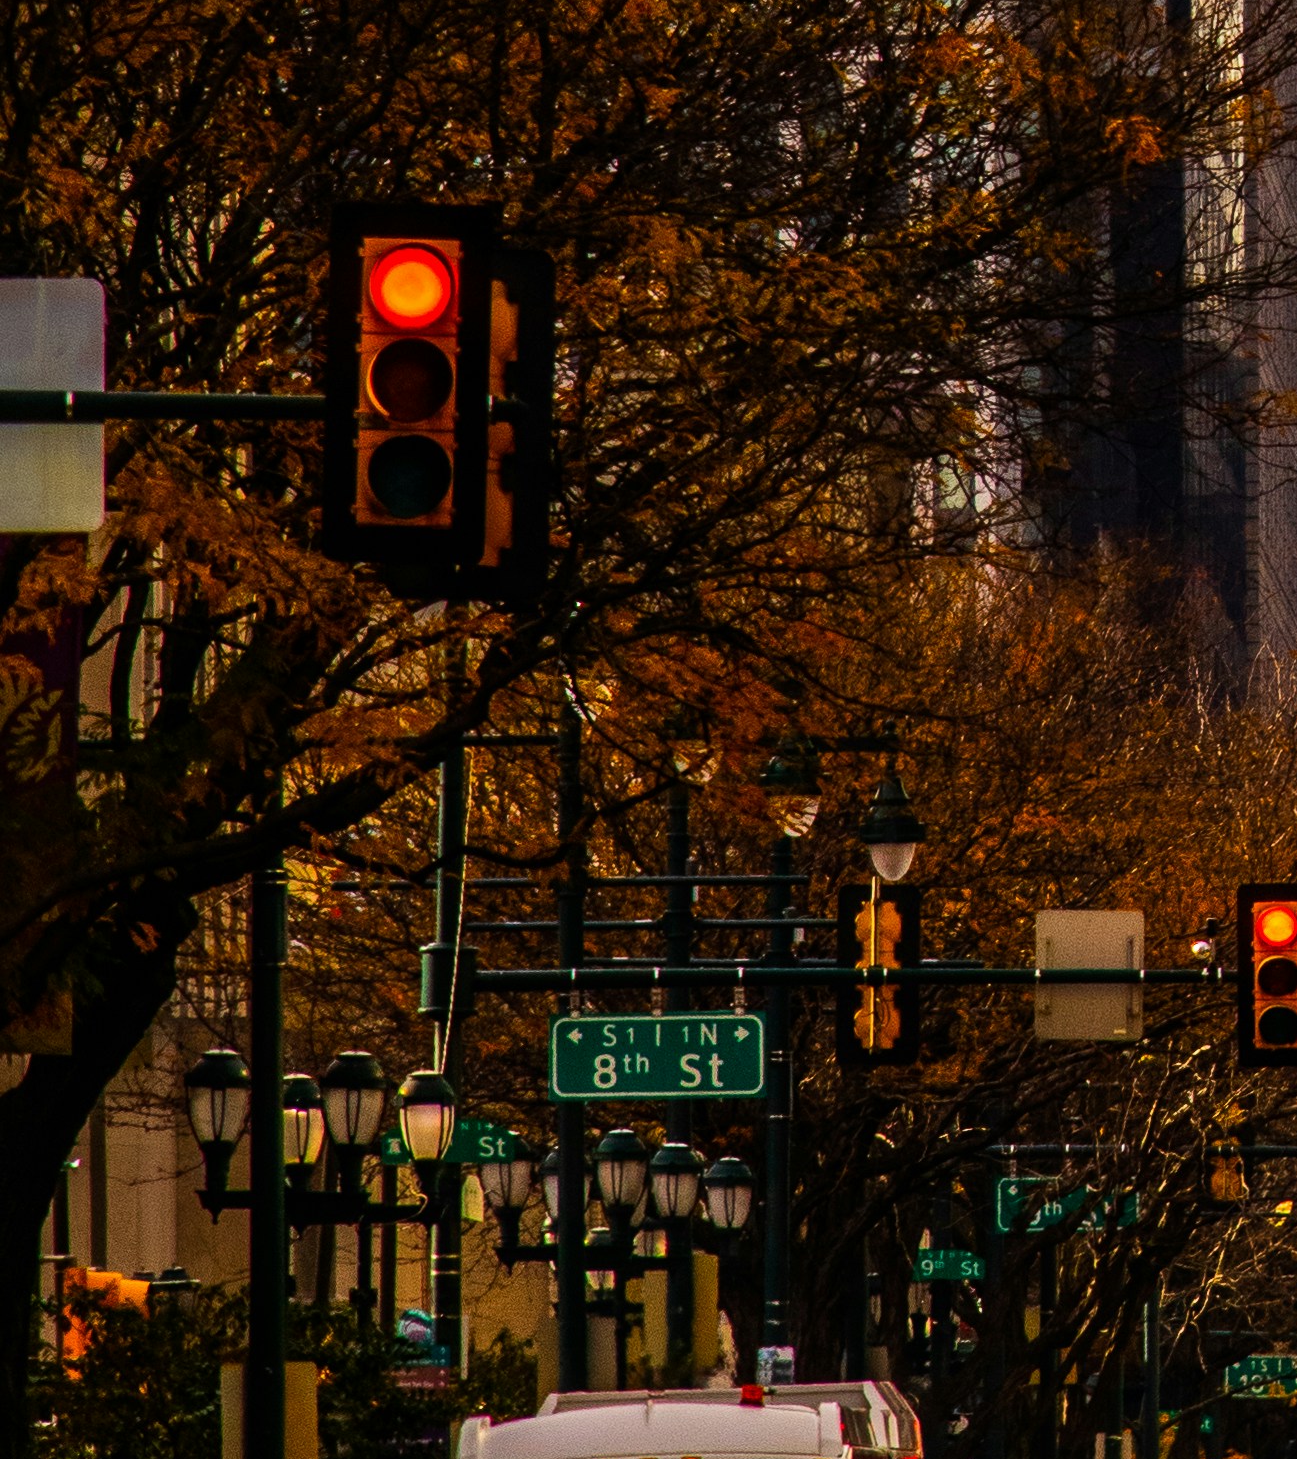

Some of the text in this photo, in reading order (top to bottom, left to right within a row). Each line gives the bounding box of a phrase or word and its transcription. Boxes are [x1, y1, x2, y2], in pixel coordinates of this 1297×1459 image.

[603, 1023, 617, 1047] S
[700, 1023, 718, 1046] N
[593, 1053, 725, 1089] 8th St
[478, 1135, 506, 1157] St
[960, 1260, 980, 1277] St
